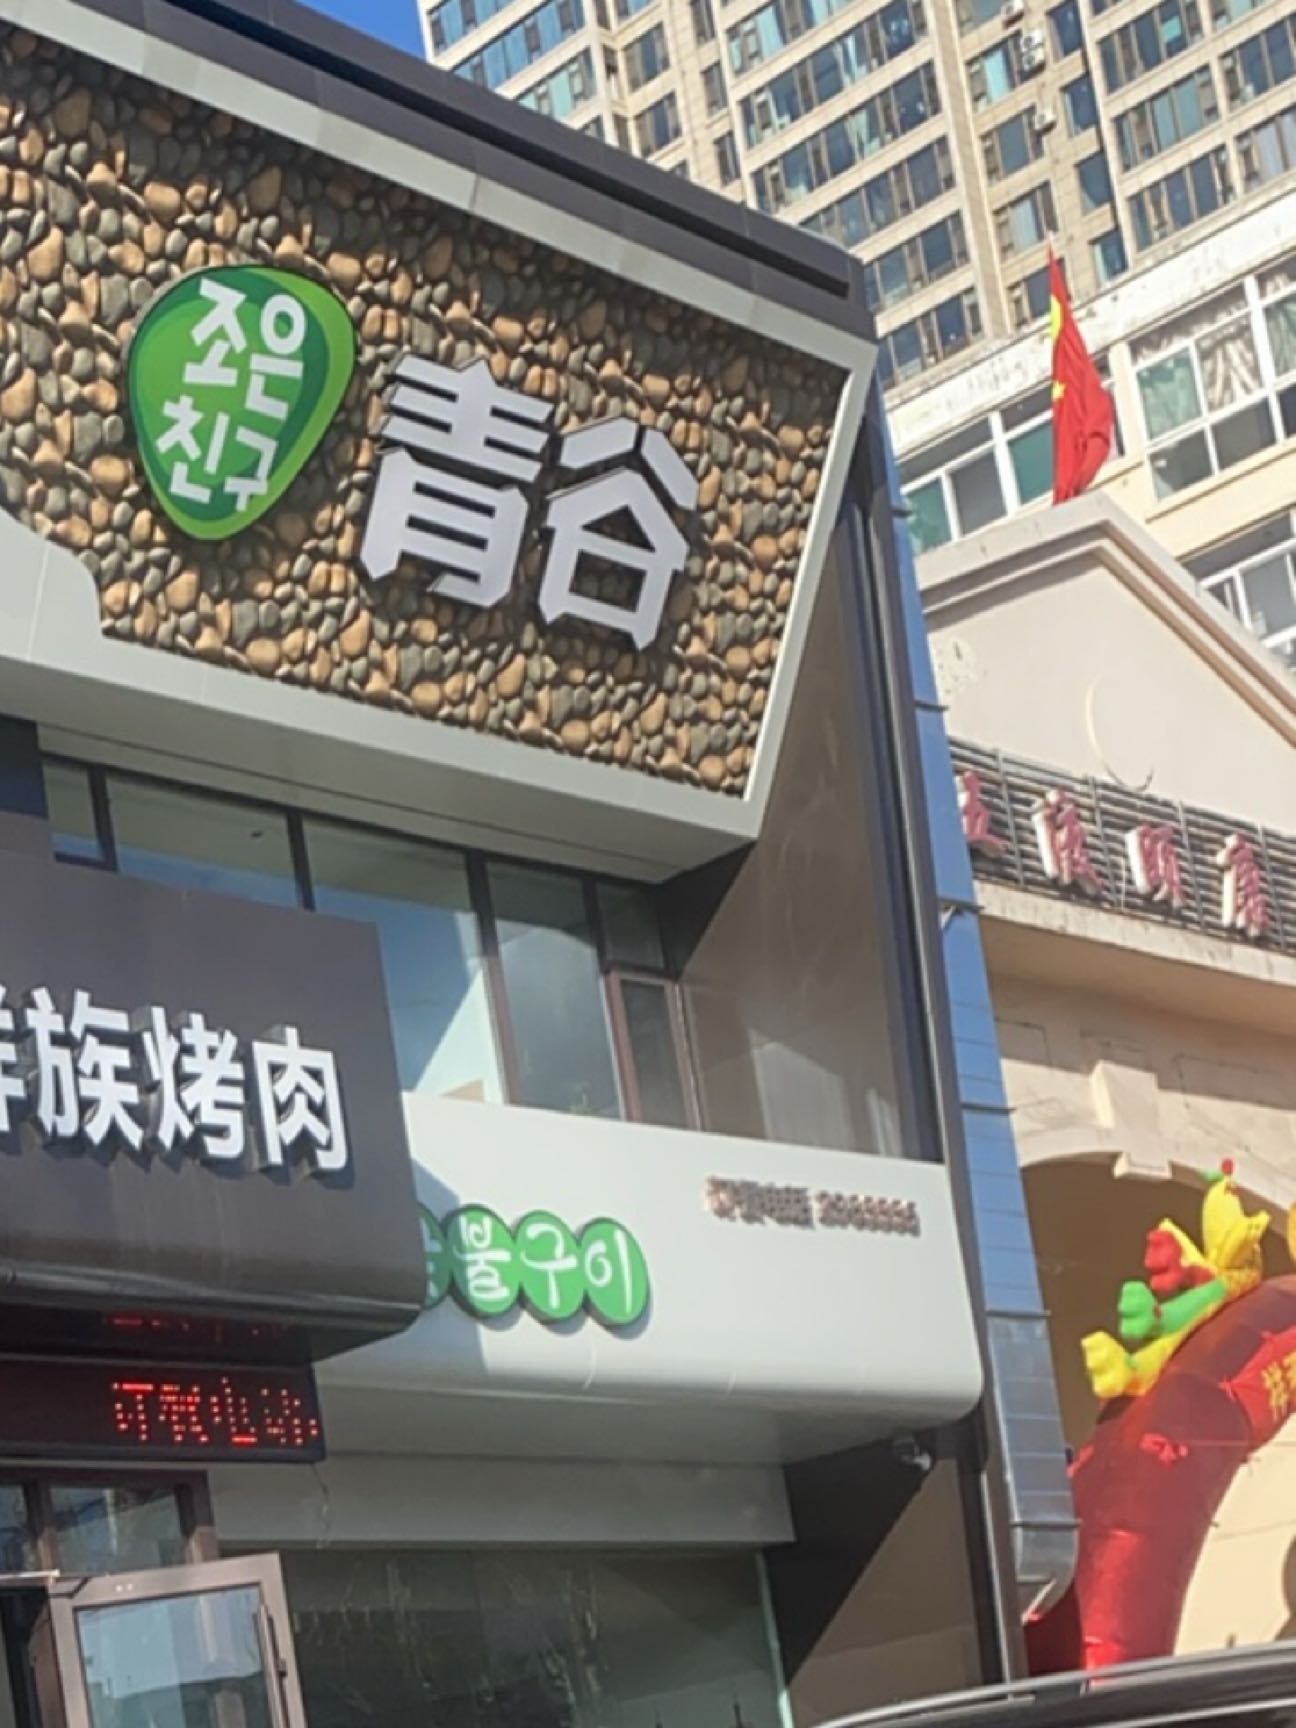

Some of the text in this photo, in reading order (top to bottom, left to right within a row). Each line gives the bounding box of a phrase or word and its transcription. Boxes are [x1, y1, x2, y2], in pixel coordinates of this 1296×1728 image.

[183, 279, 306, 420] 조은
[156, 395, 279, 512] 친구
[360, 355, 700, 651] 青谷
